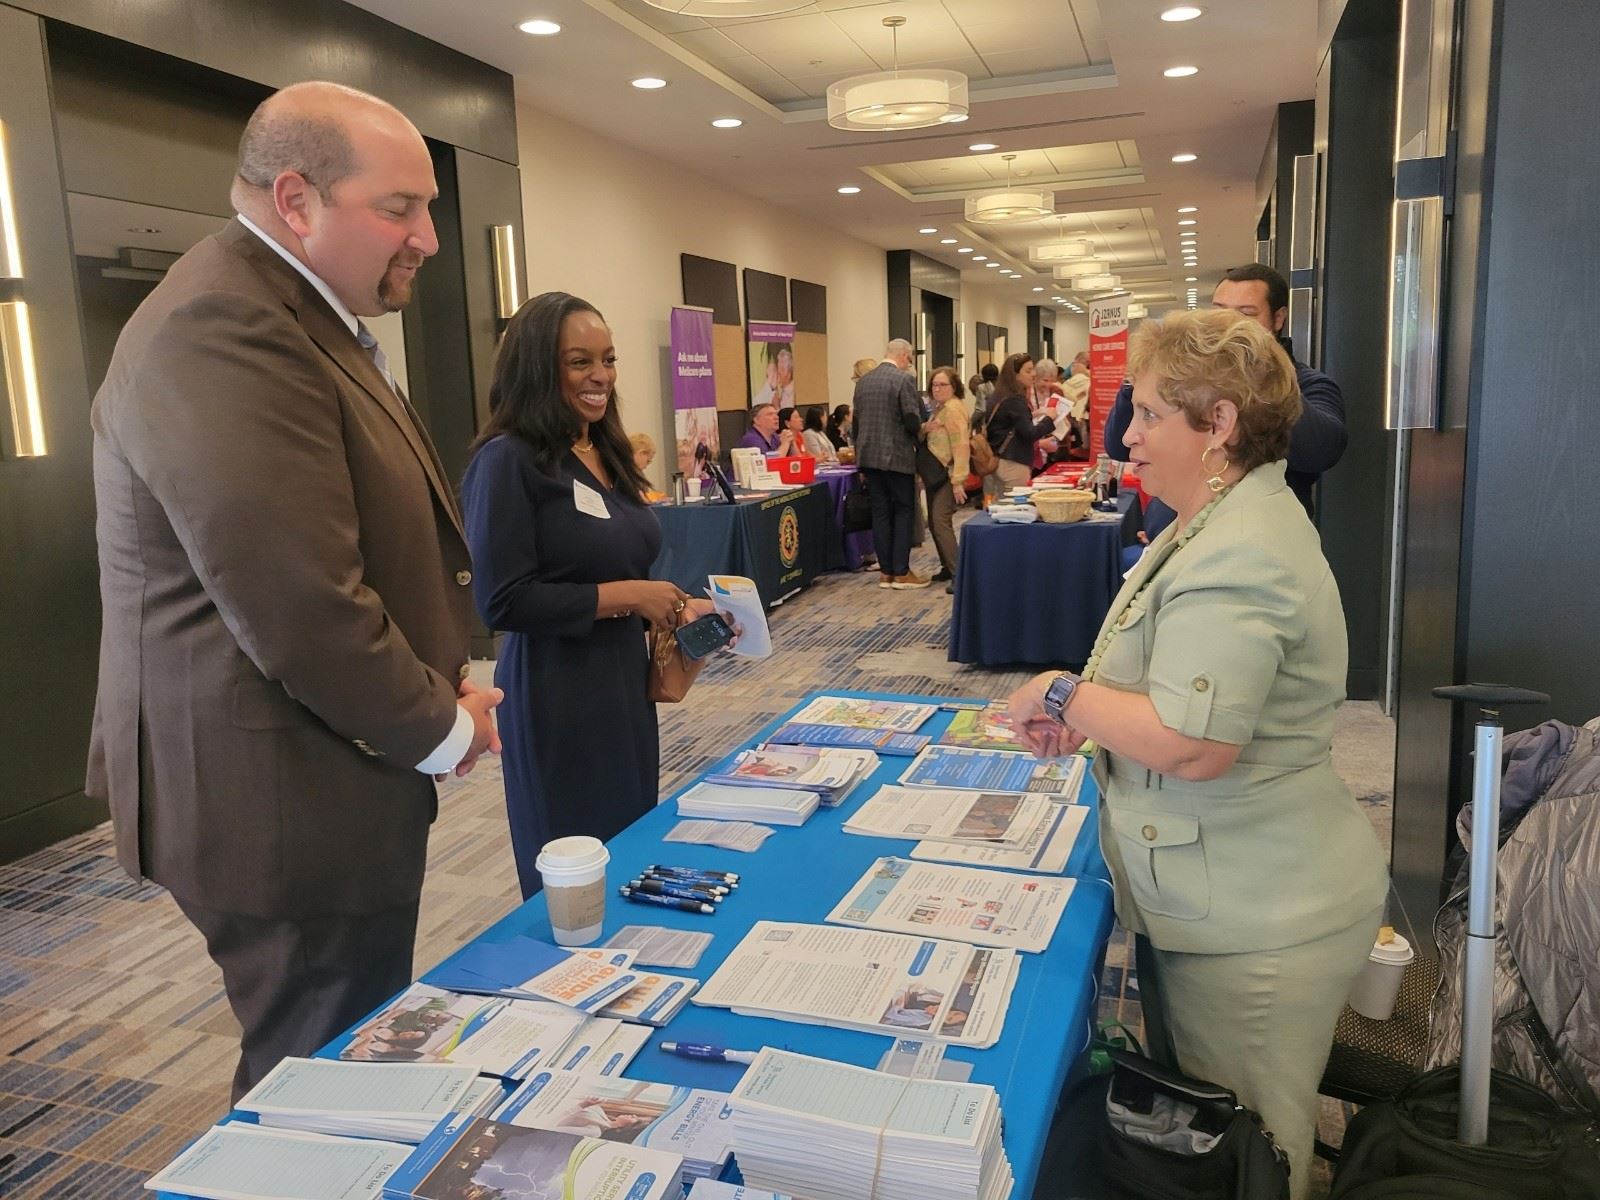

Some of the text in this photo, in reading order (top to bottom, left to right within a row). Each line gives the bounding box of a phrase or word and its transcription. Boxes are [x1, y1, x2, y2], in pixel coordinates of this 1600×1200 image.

[558, 966, 616, 1000] GUIDE
[671, 1096, 705, 1141] ENERGY BILLS
[617, 1160, 638, 1184] UTILITY
